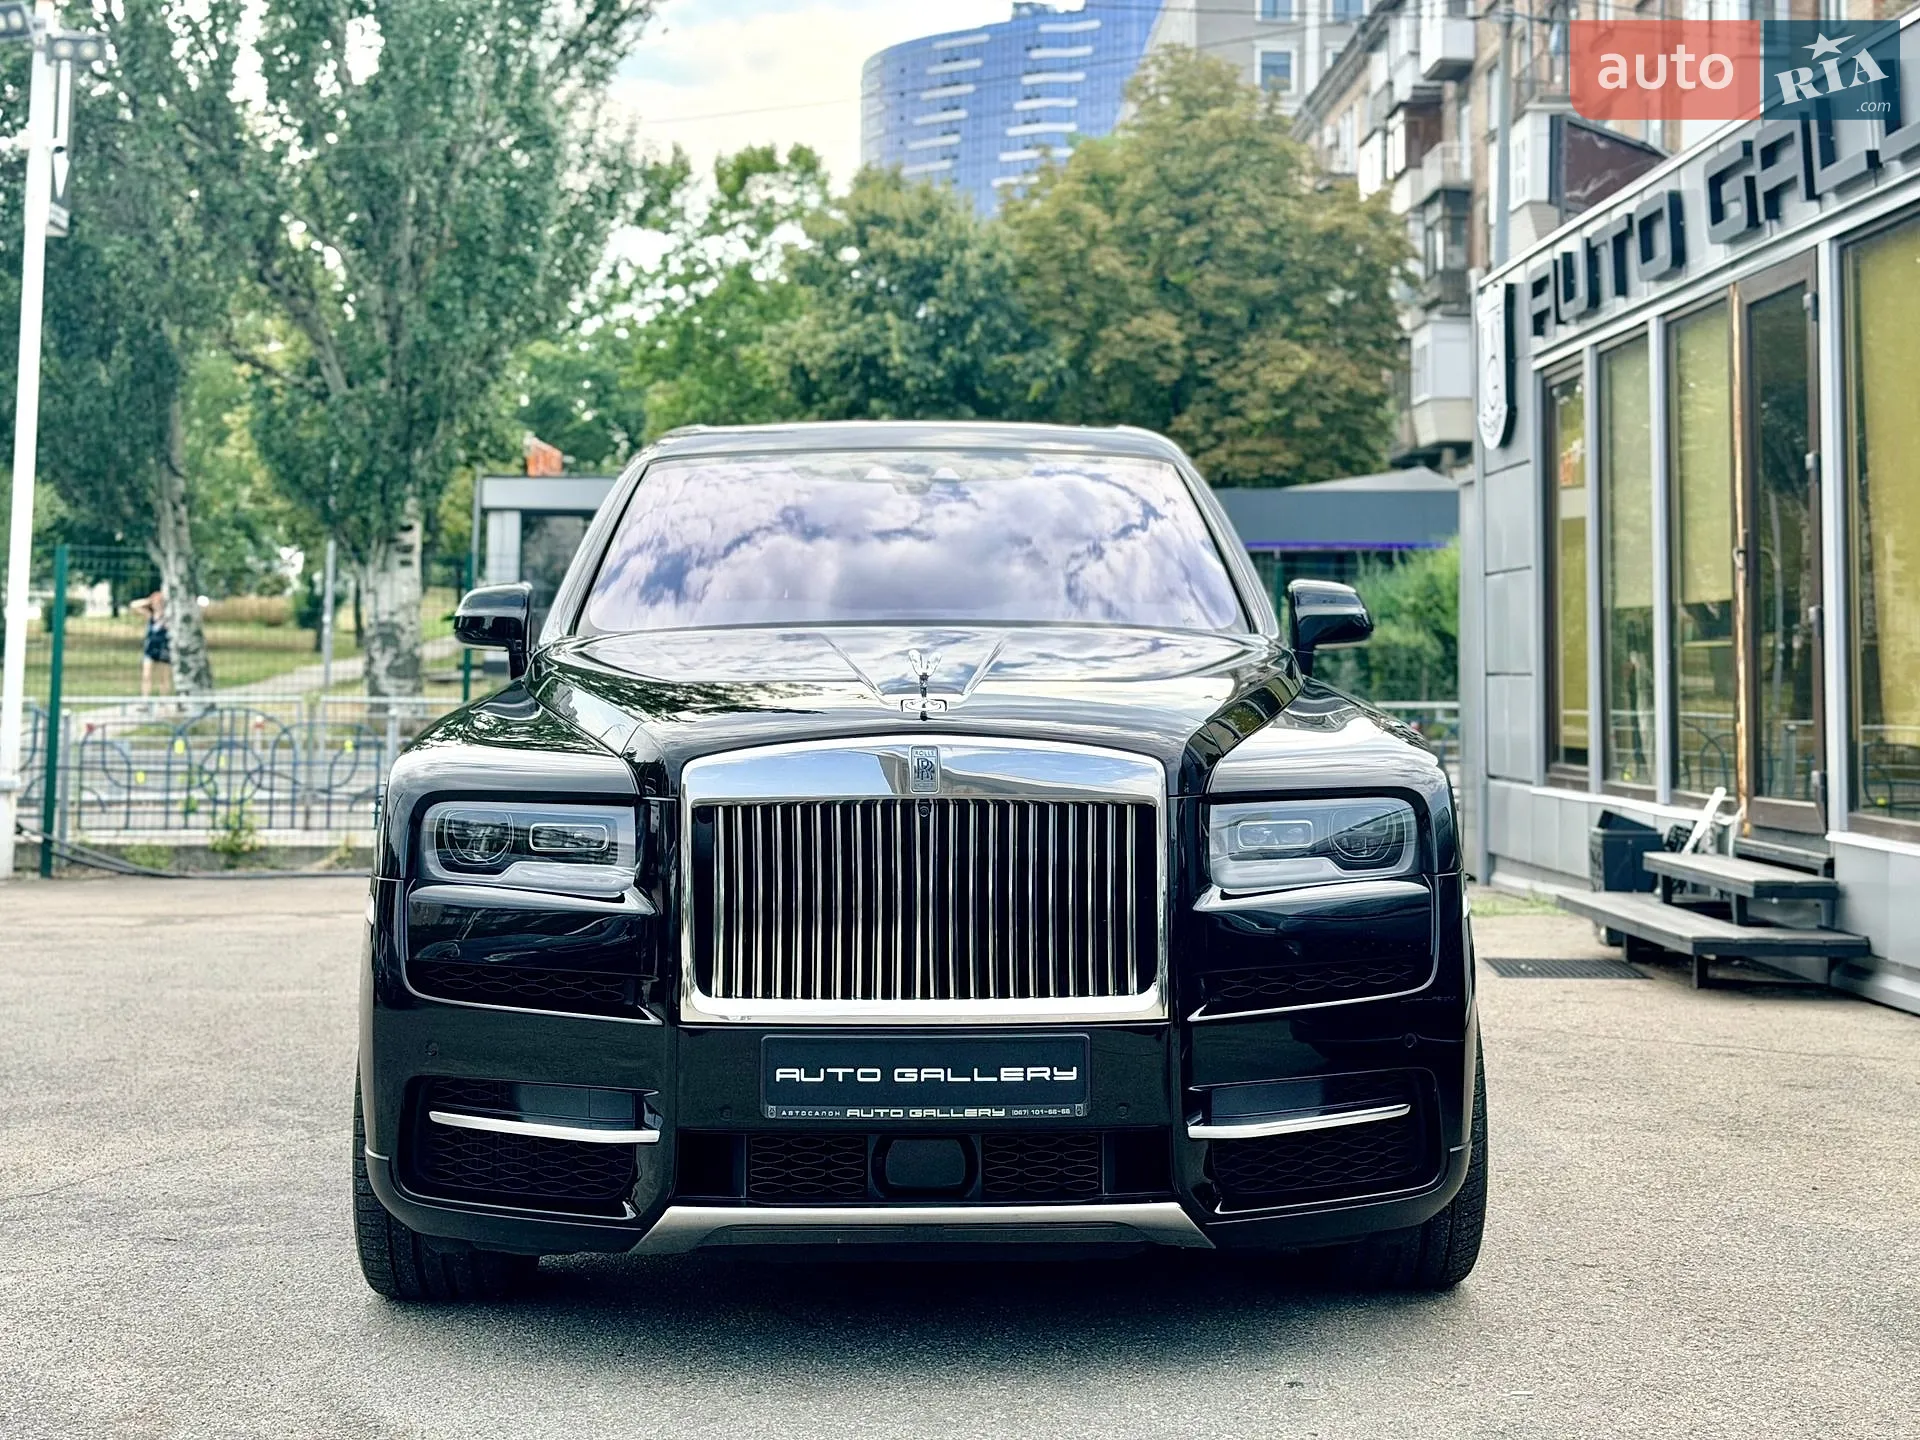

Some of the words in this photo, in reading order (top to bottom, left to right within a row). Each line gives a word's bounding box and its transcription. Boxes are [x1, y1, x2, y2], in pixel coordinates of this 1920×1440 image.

[1529, 190, 1684, 338] AUTO
[776, 1068, 881, 1082] AUTO
[894, 1066, 1077, 1082] GALLERY
[846, 1108, 904, 1118] AUTO
[909, 1108, 1005, 1118] GALLERY
